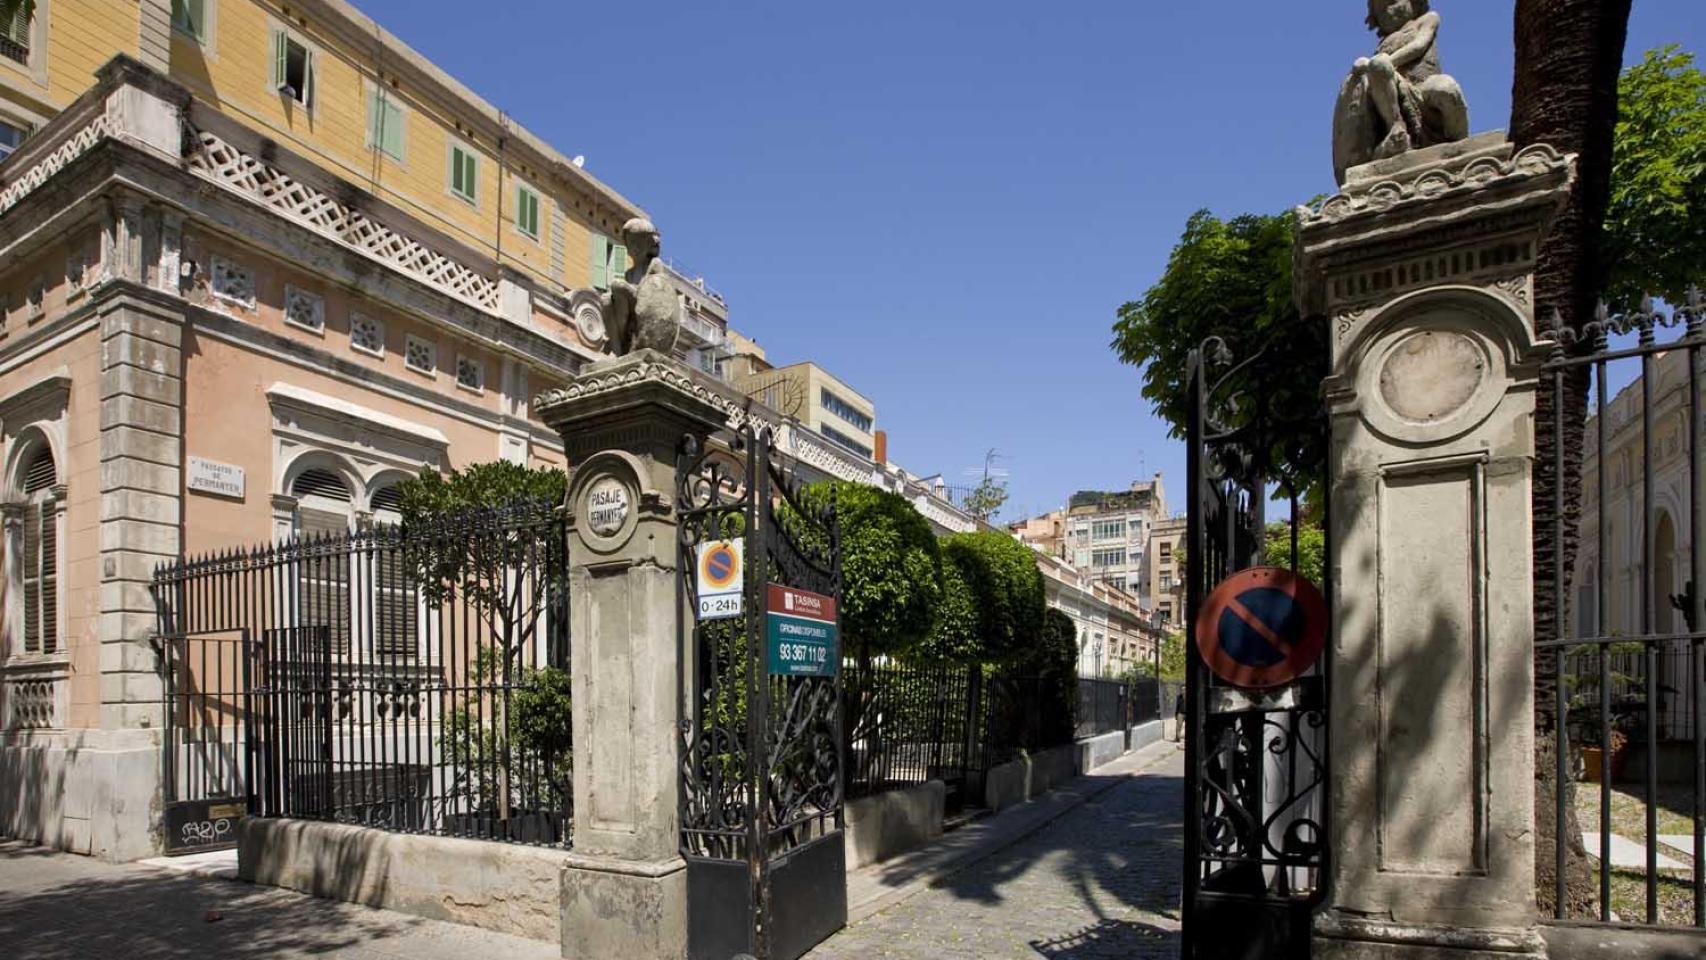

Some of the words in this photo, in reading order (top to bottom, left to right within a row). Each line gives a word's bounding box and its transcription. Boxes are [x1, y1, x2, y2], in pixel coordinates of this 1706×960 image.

[591, 489, 622, 506] PASAJE
[794, 594, 821, 608] TASINSA
[779, 643, 791, 660] 93
[792, 644, 807, 661] 367
[808, 646, 816, 662] 11
[817, 646, 827, 662] 02
